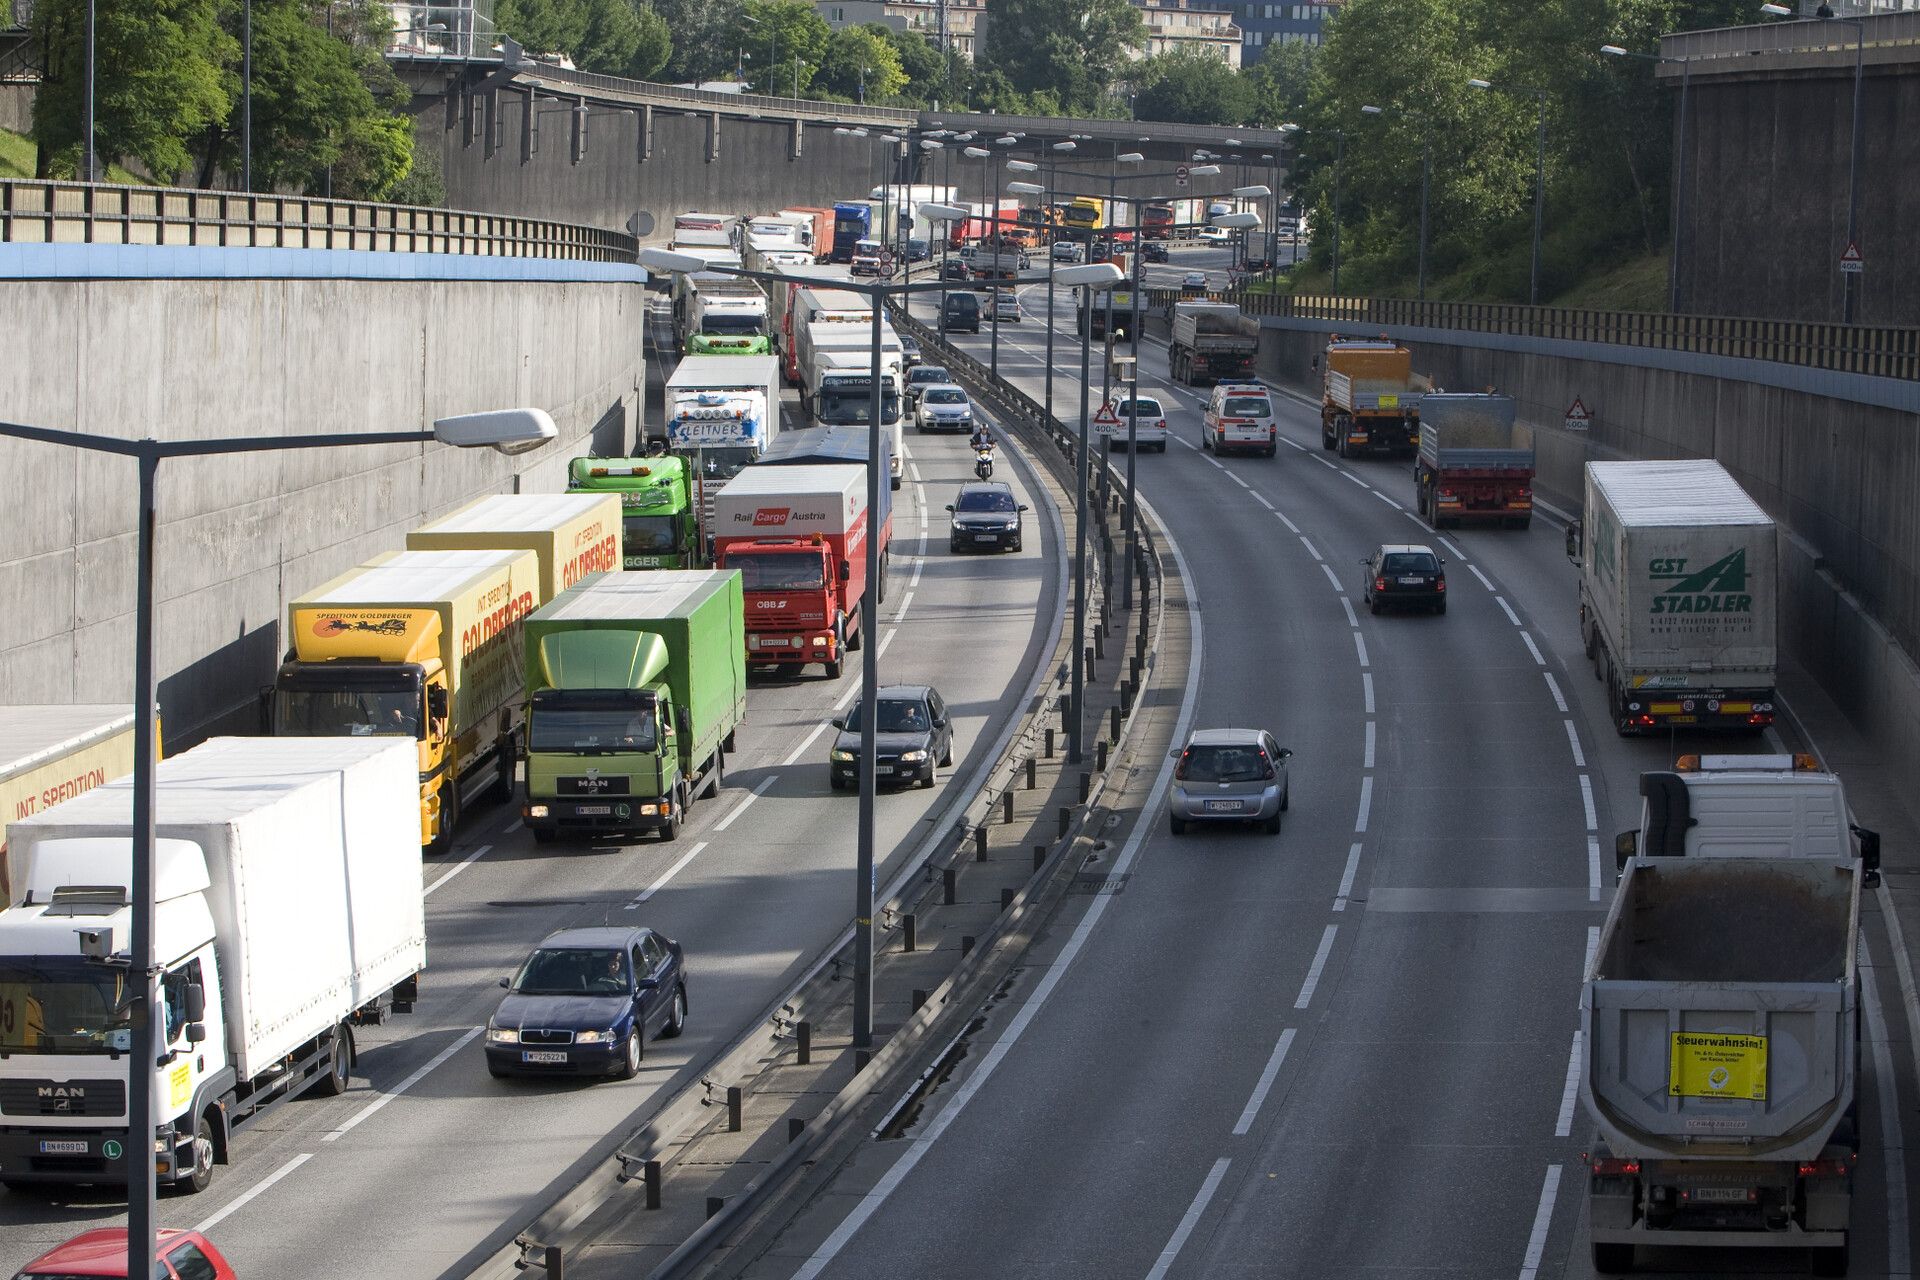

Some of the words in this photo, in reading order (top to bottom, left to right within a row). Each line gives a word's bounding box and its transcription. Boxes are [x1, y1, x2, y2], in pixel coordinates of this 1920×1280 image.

[686, 424, 738, 436] LEITNER
[734, 513, 752, 522] Rail
[756, 511, 786, 523] Cargo
[791, 512, 826, 521] Austria
[624, 556, 660, 567] GGER
[1649, 558, 1689, 573] GST
[1649, 594, 1752, 613] STADLER
[463, 590, 534, 669] GOLDBERGER
[16, 795, 40, 821] INT.
[42, 767, 105, 810] SPEDITION
[37, 1087, 85, 1097] MAN
[107, 1144, 117, 1157] L
